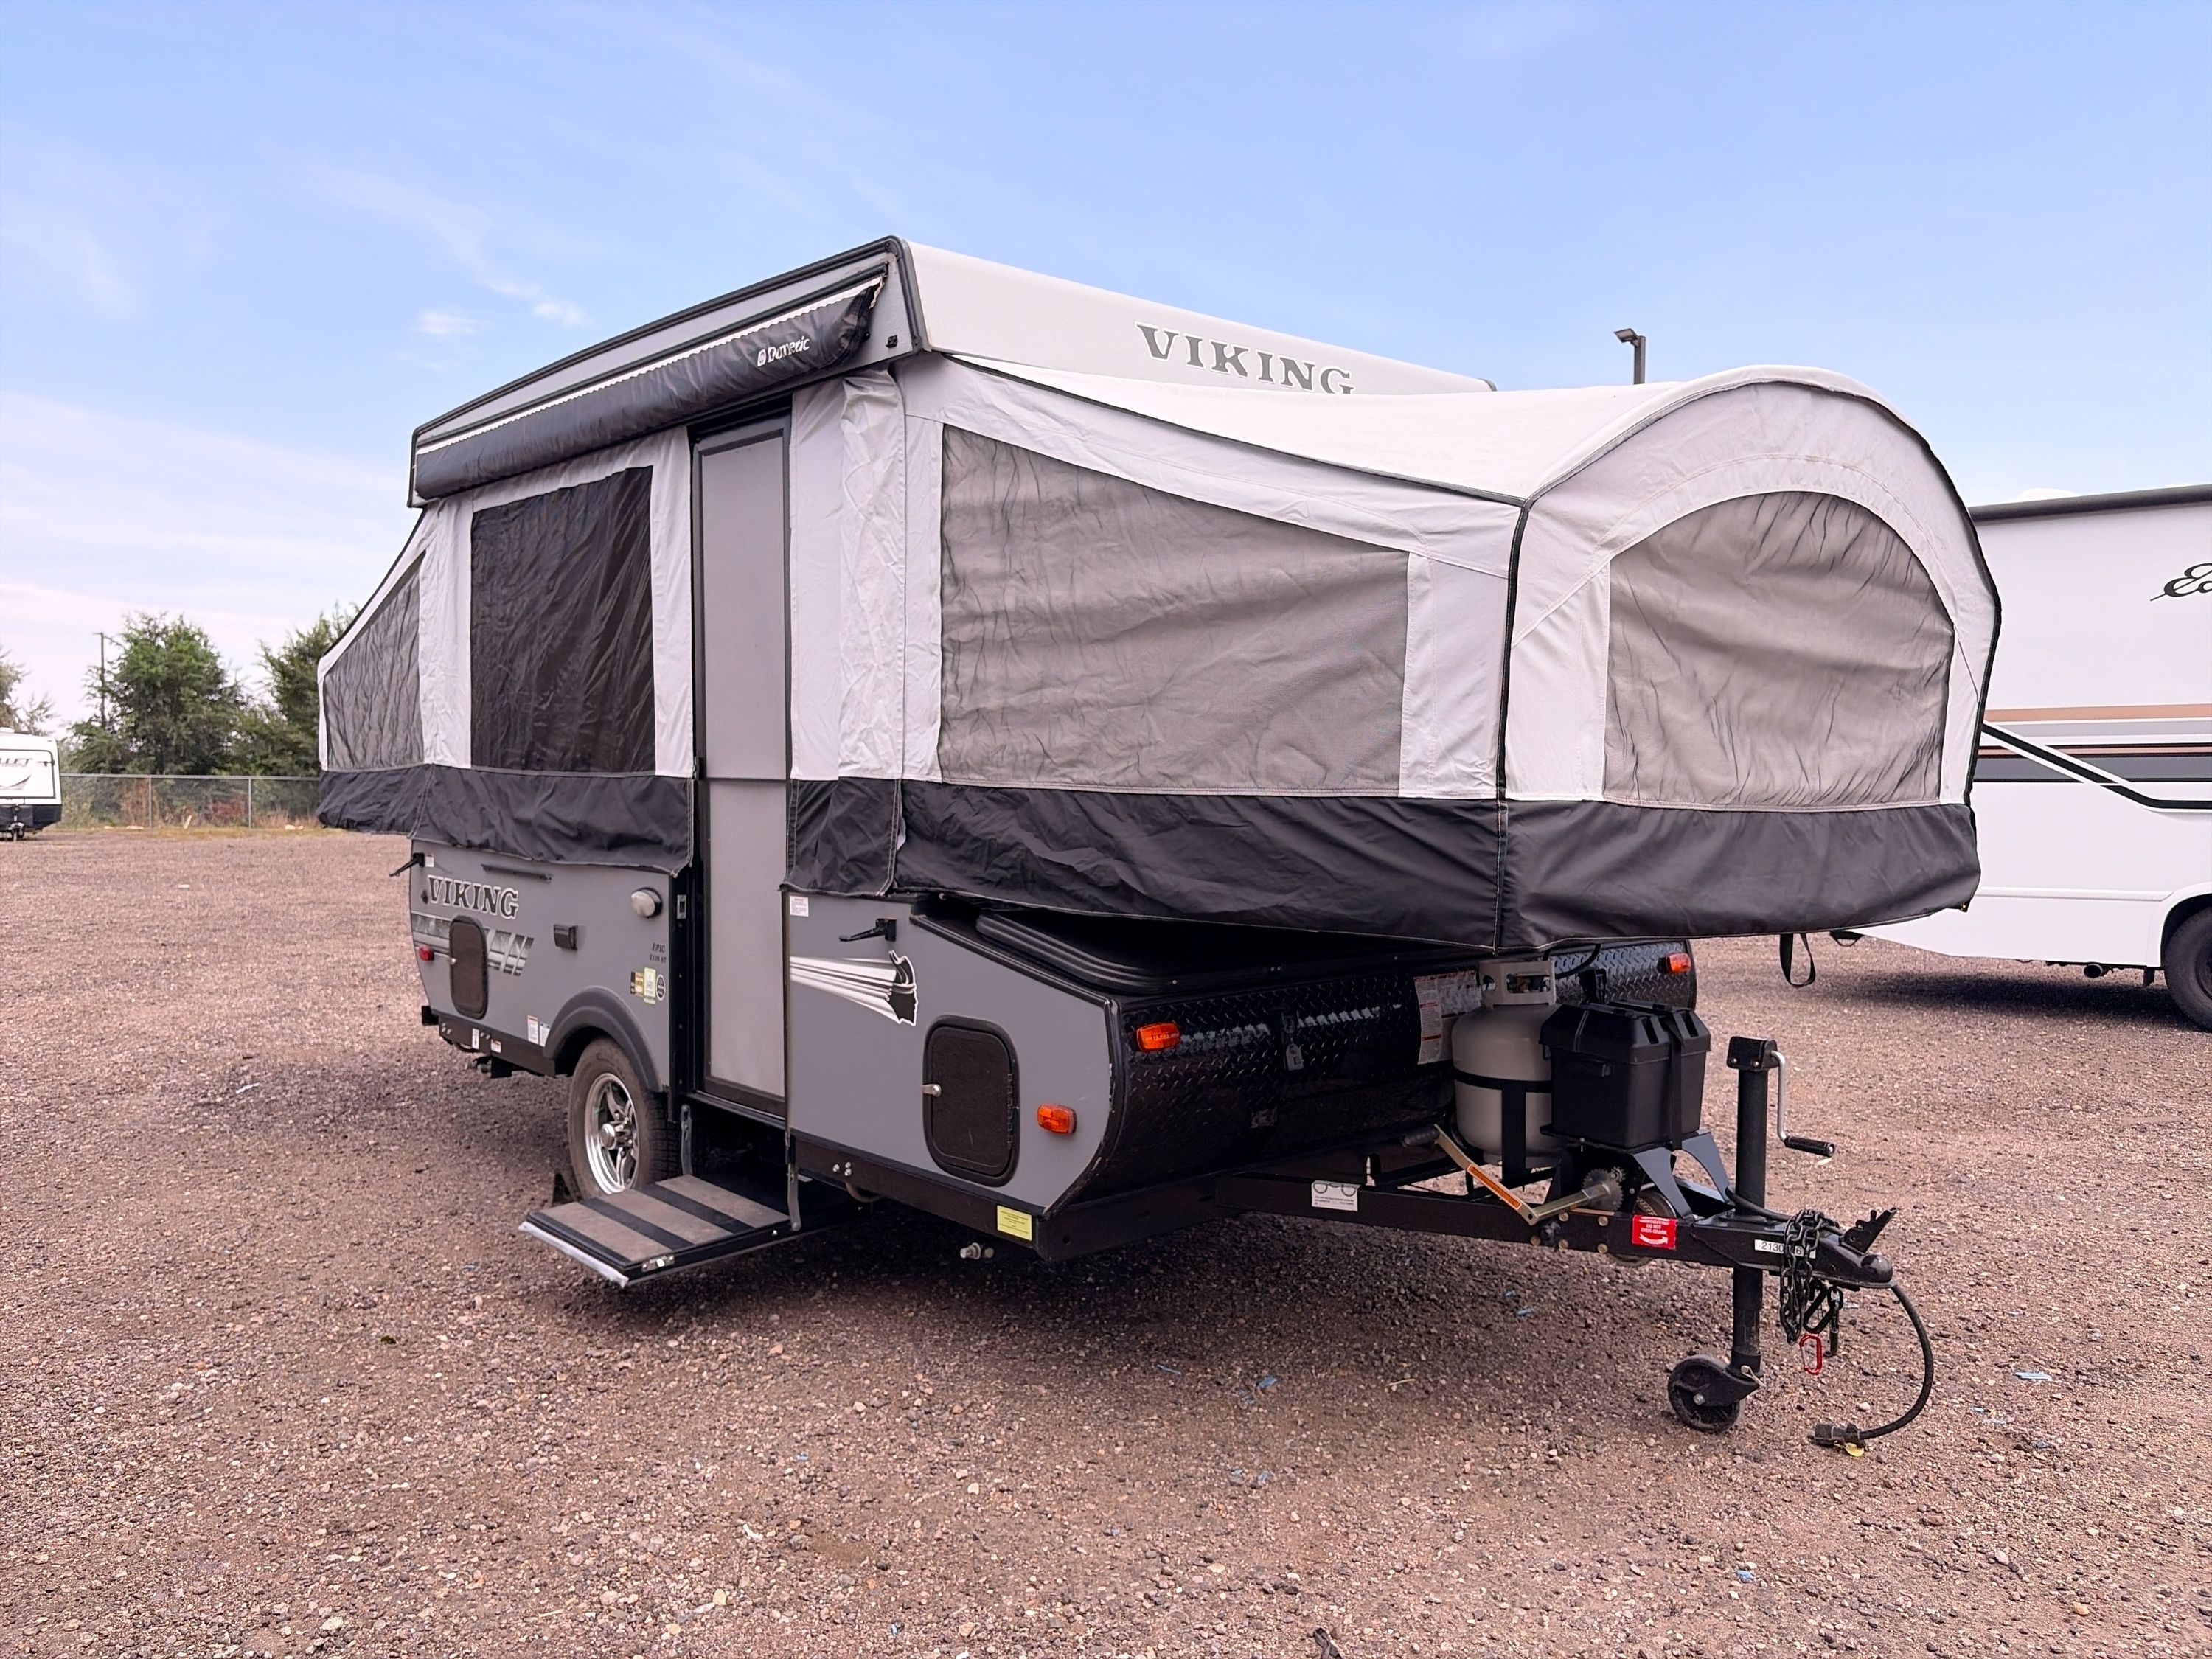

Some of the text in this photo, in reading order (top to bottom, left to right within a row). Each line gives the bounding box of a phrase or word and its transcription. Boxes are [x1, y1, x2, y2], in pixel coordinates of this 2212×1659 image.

[1136, 323, 1354, 394] VIKING
[428, 875, 519, 919] VIKING
[652, 943, 665, 953] EPIC
